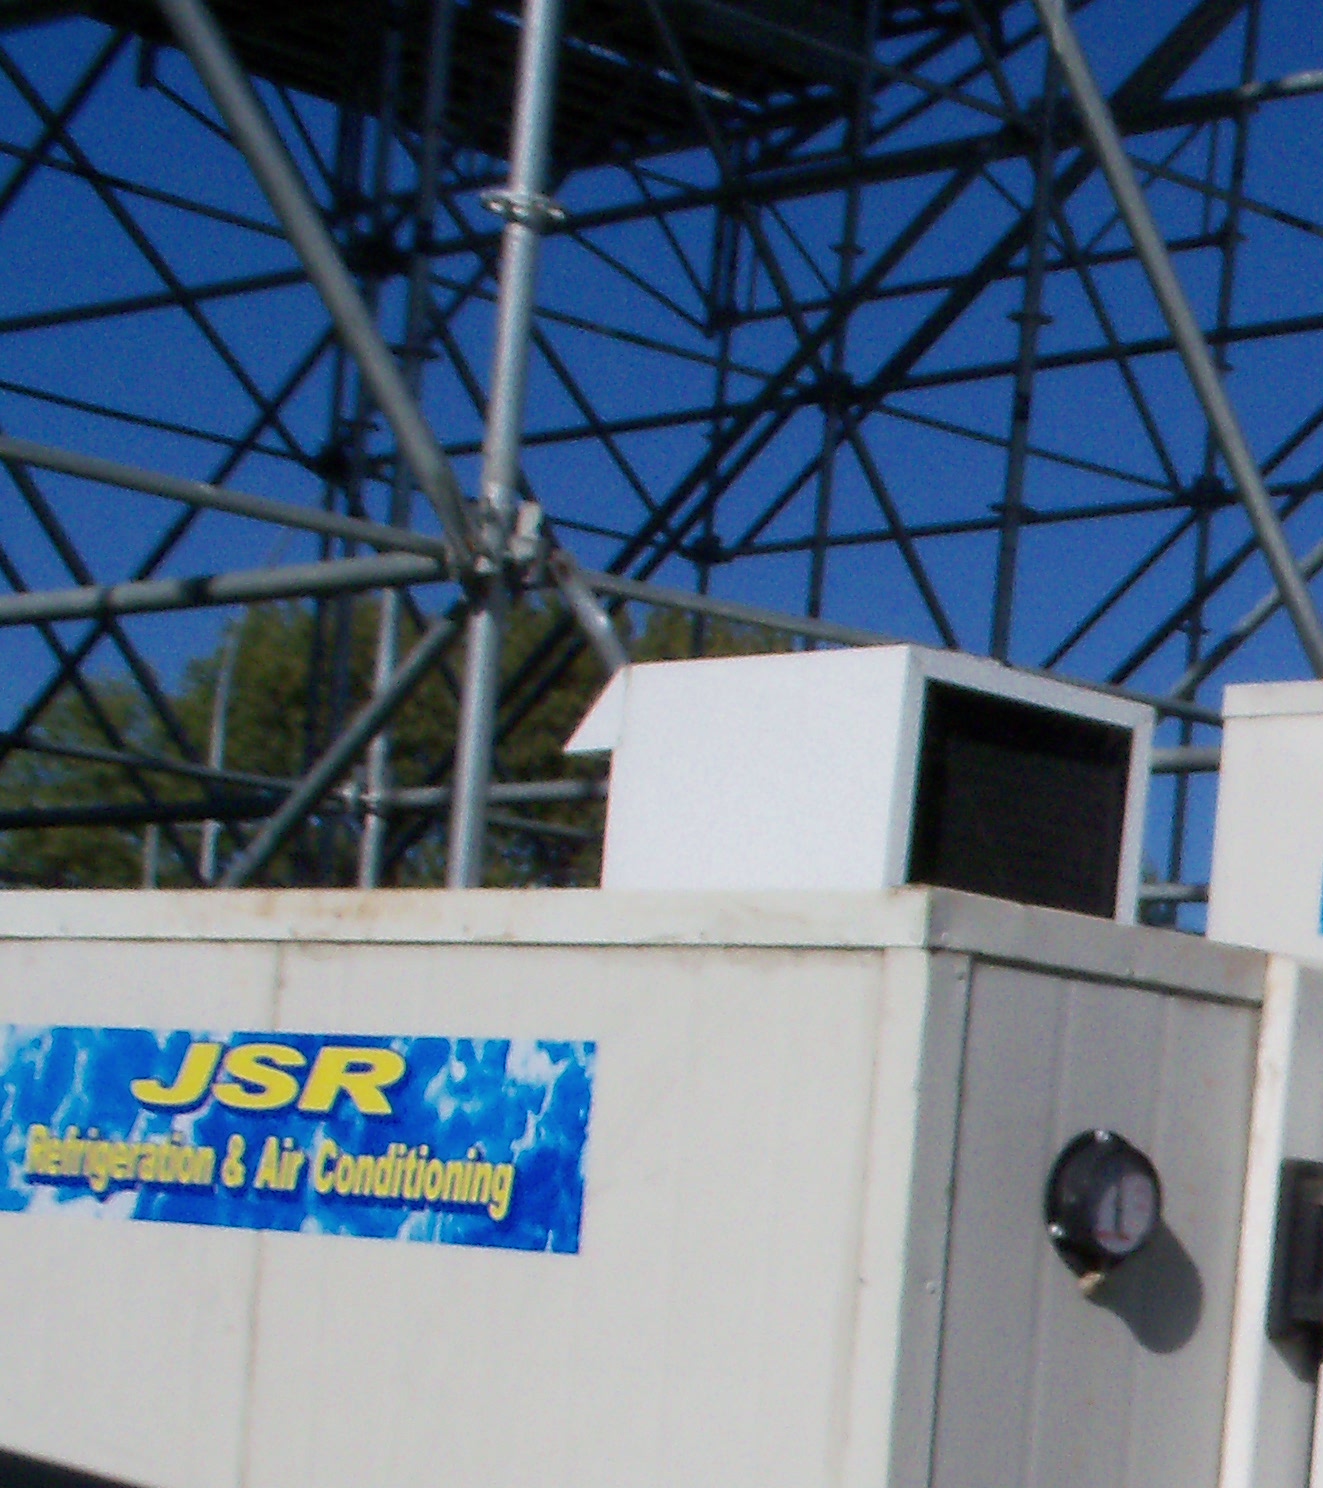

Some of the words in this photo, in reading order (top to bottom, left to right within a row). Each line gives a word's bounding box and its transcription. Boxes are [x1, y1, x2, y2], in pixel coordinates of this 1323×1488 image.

[131, 1041, 406, 1116] JSR
[25, 1122, 216, 1192] Refrigeration
[221, 1134, 247, 1189] &
[253, 1136, 305, 1191] Air
[313, 1140, 516, 1222] Conditioning
